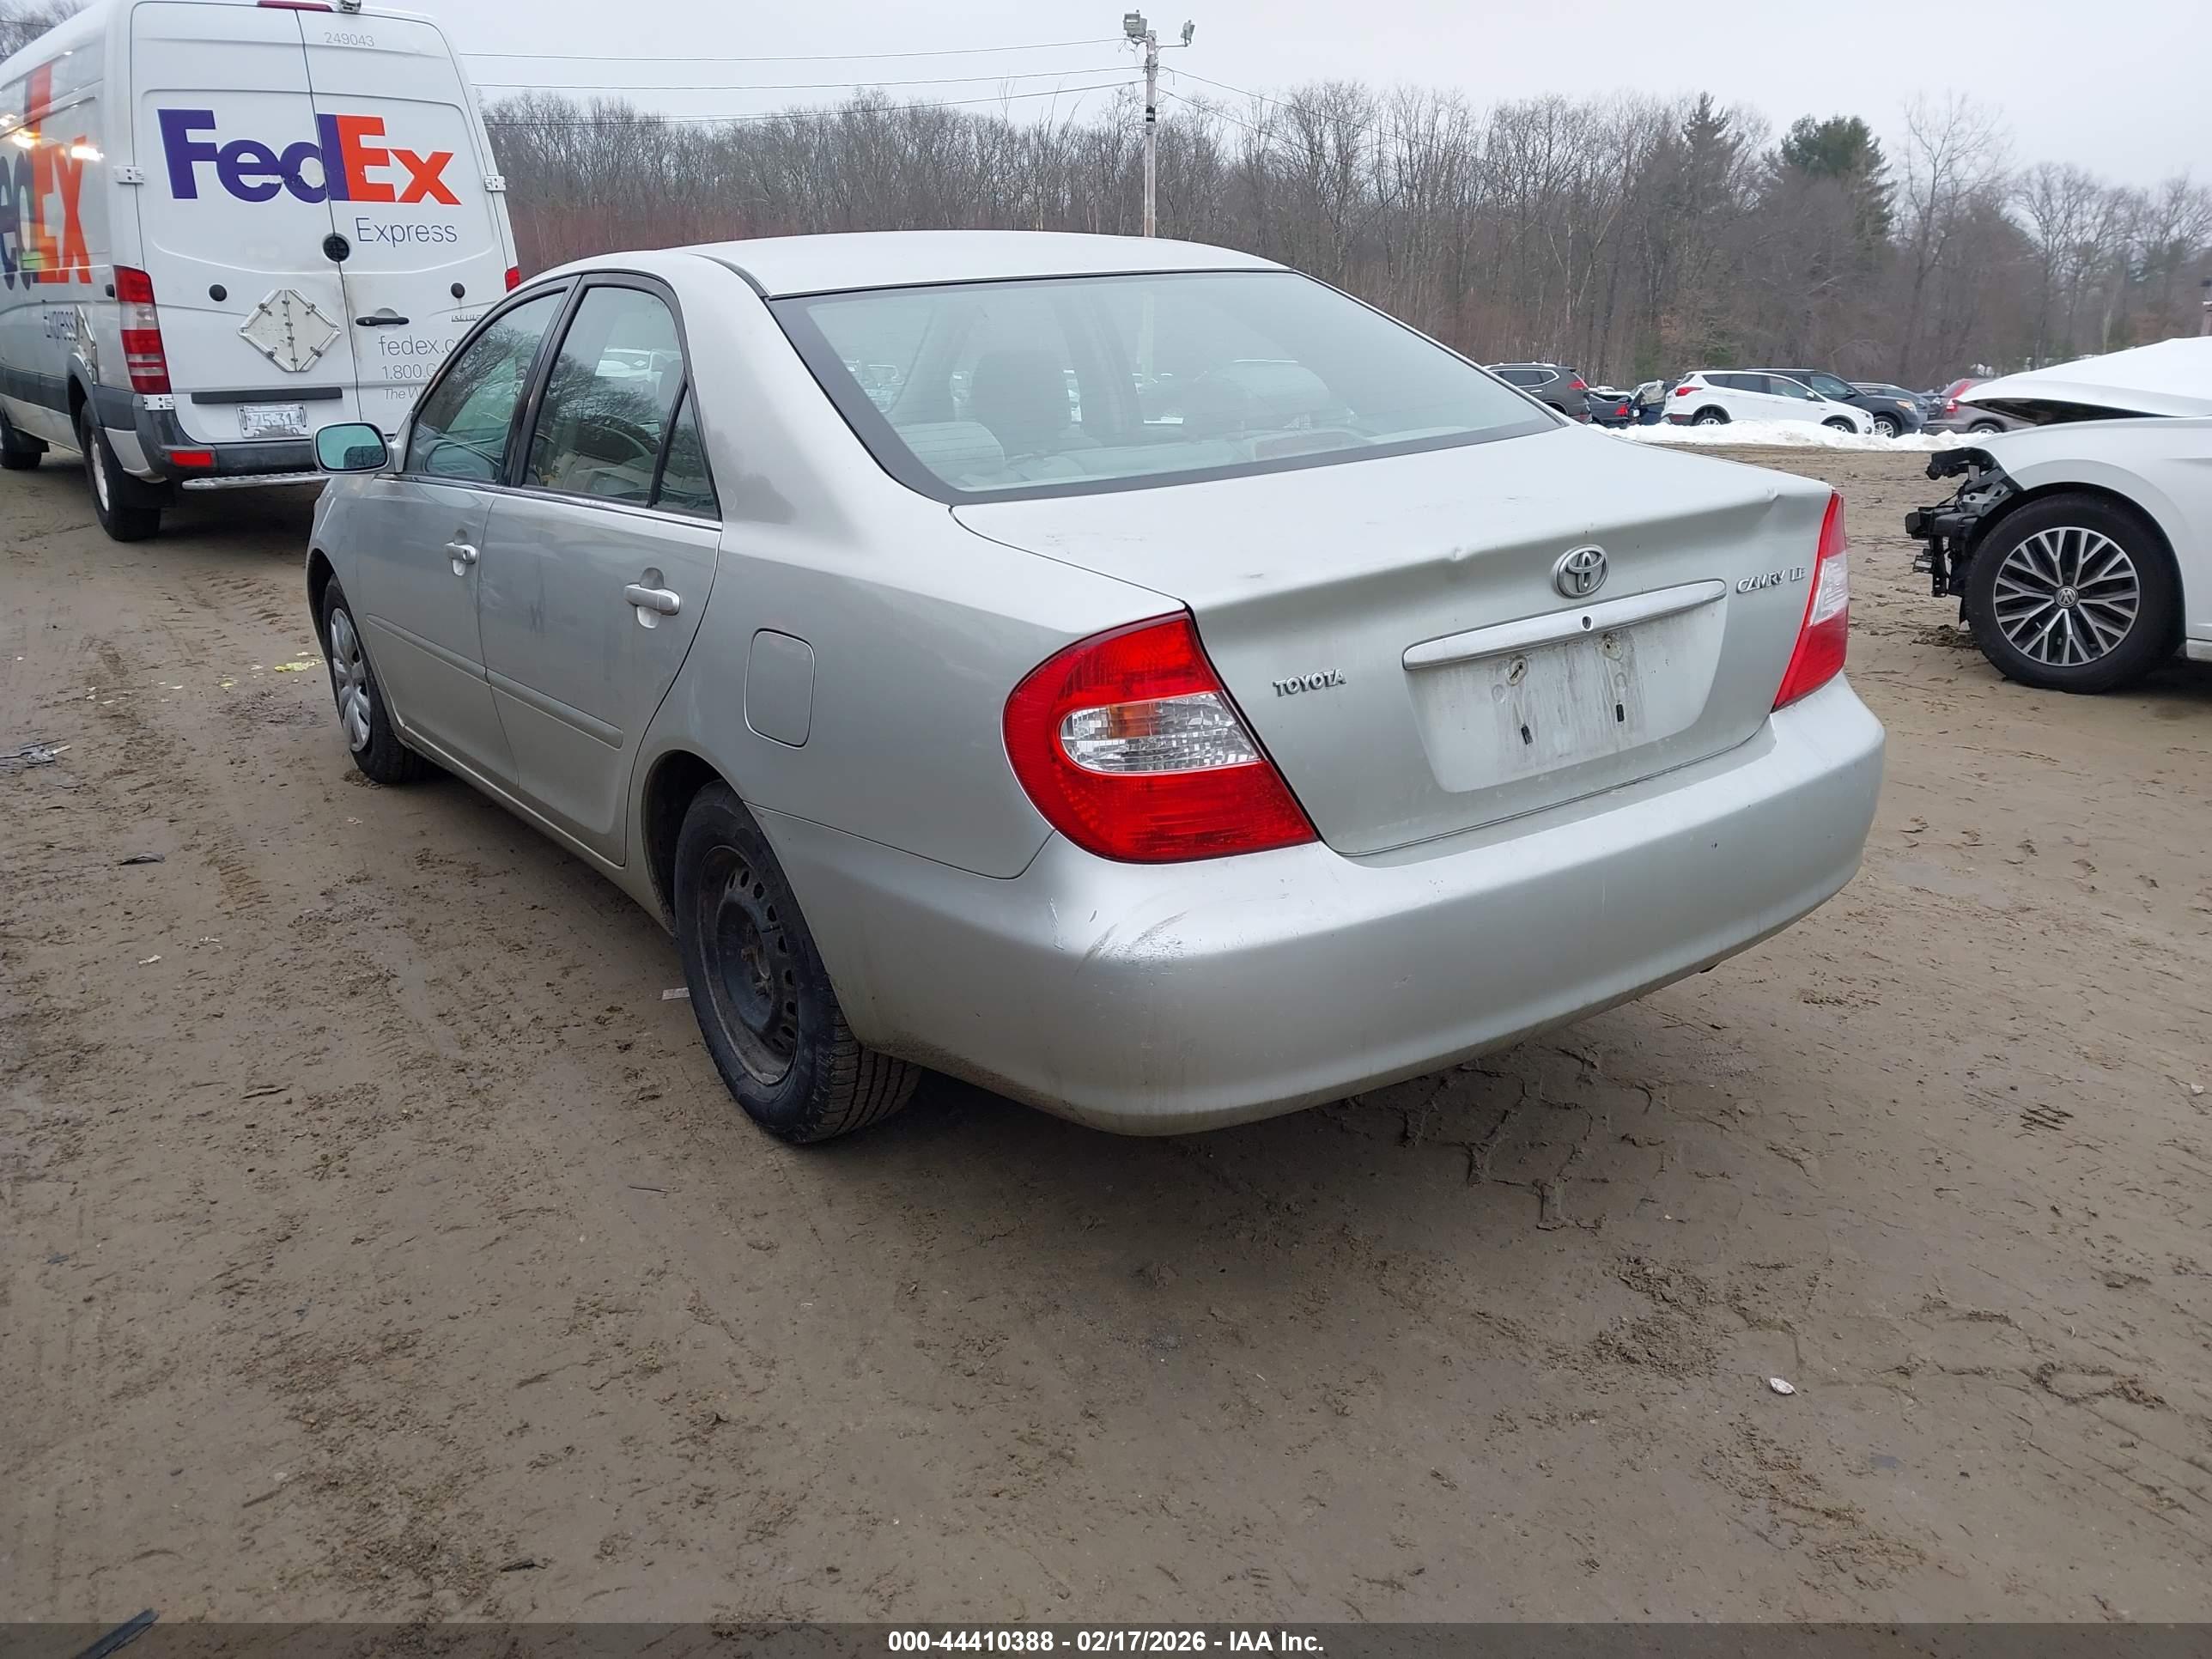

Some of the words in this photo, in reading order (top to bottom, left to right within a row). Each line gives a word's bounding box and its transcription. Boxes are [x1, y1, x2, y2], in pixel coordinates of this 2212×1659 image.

[324, 31, 375, 47] 249043
[157, 108, 463, 204] FedEx
[355, 216, 459, 247] Express
[384, 387, 406, 400] The
[1736, 569, 1786, 594] CAMRY
[1790, 568, 1806, 581] LE
[1272, 667, 1347, 697] TOYOTA
